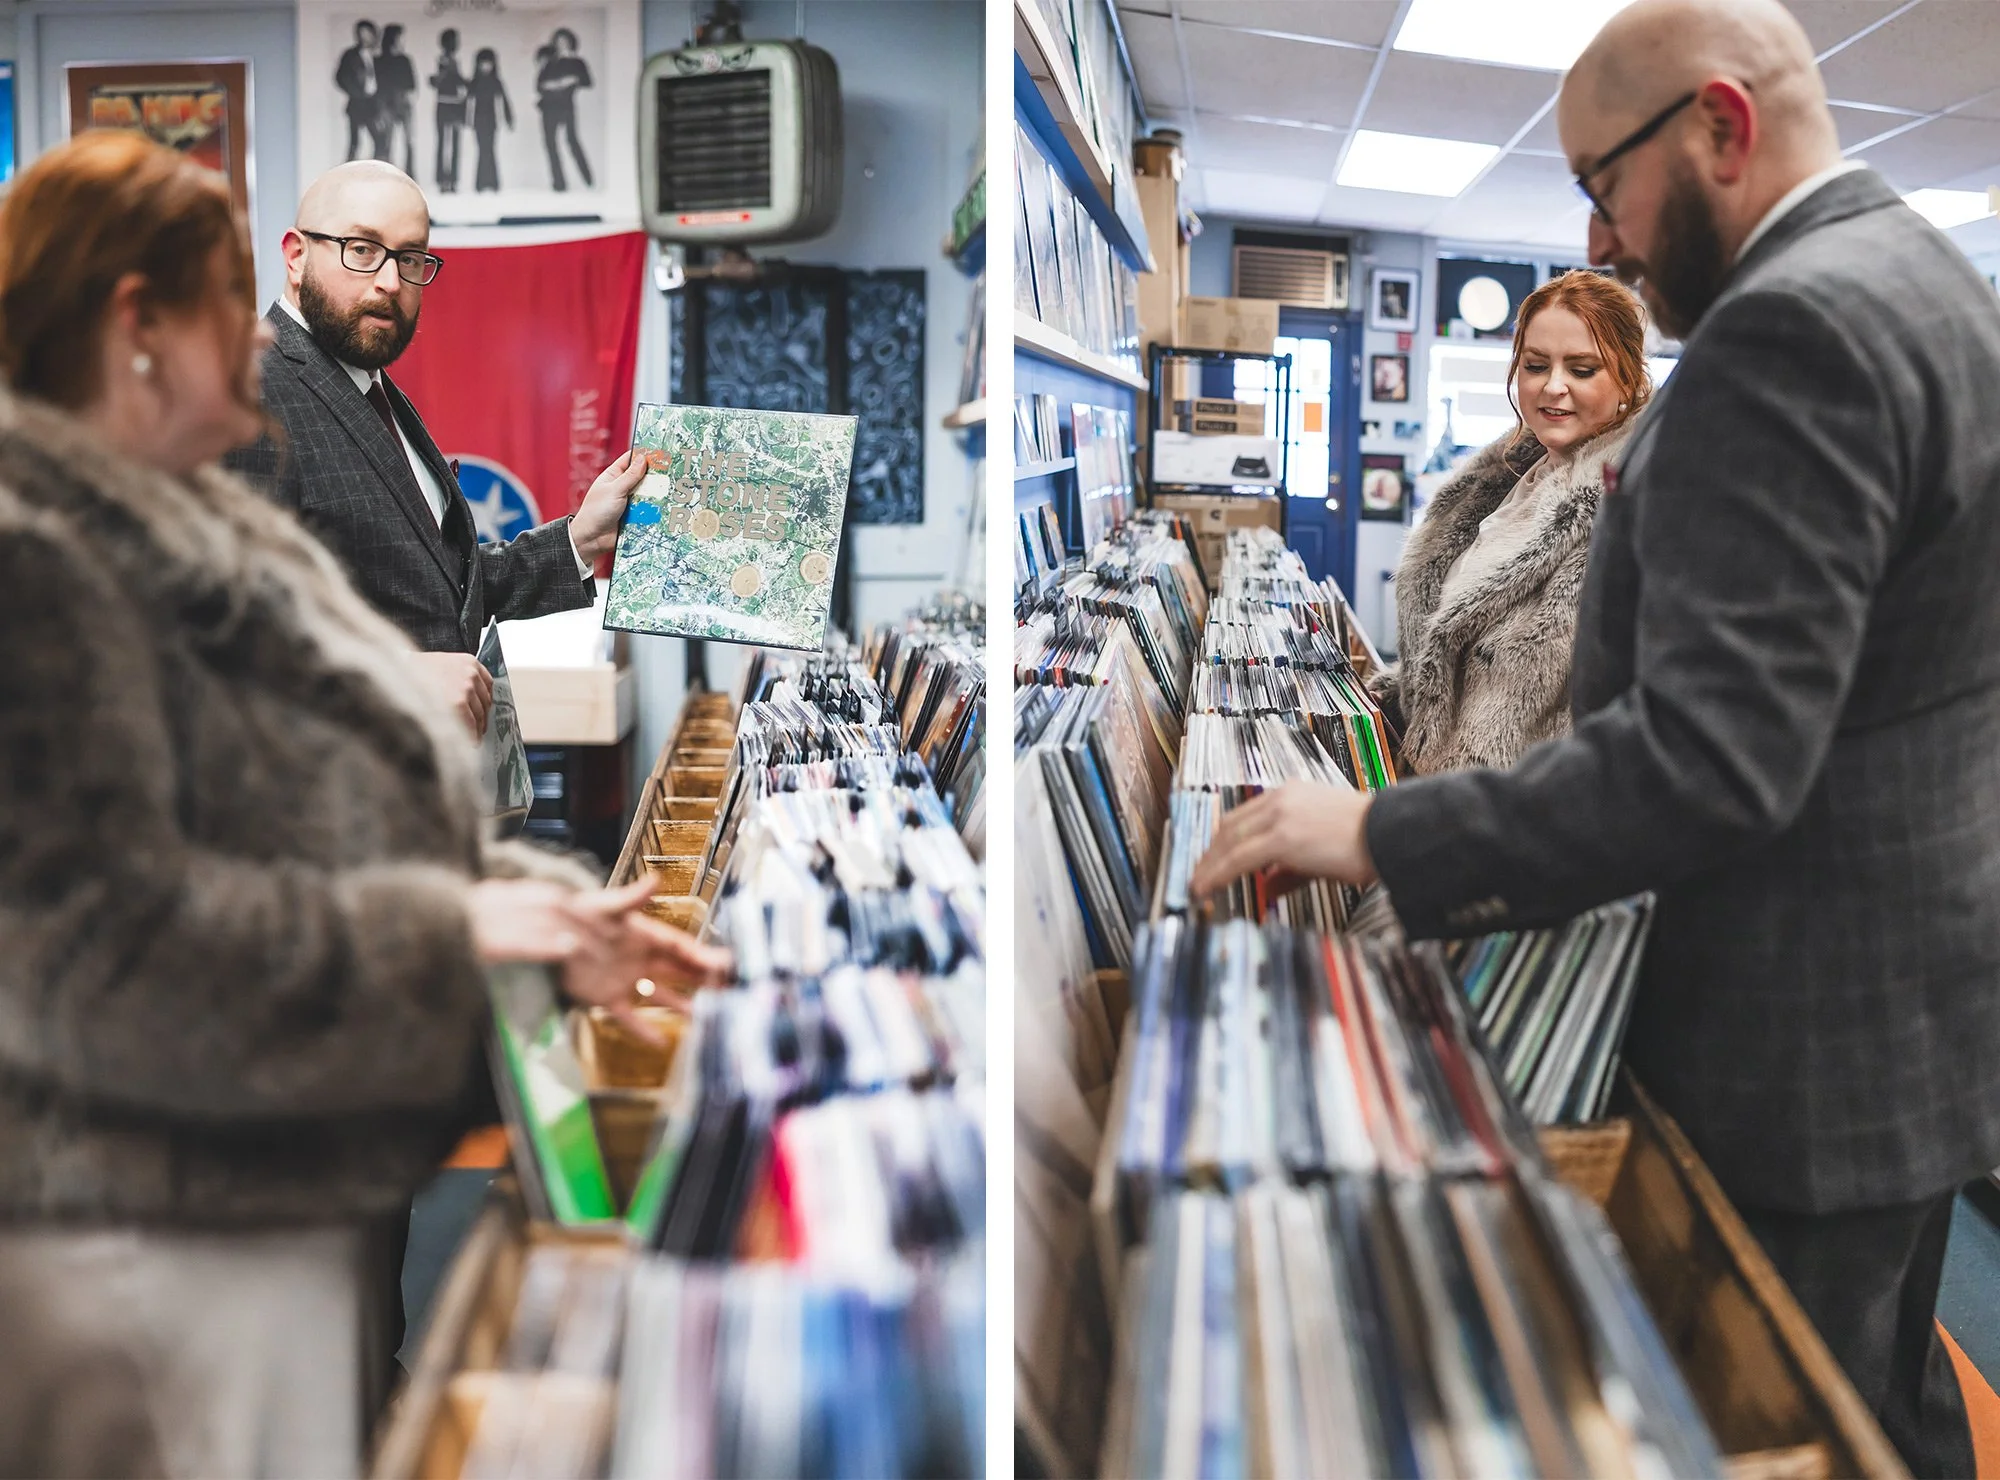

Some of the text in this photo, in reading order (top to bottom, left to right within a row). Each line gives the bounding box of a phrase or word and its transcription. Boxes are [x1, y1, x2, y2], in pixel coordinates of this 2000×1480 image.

[680, 448, 750, 478] THE
[672, 477, 791, 512] STONE
[668, 507, 788, 541] ROSES
